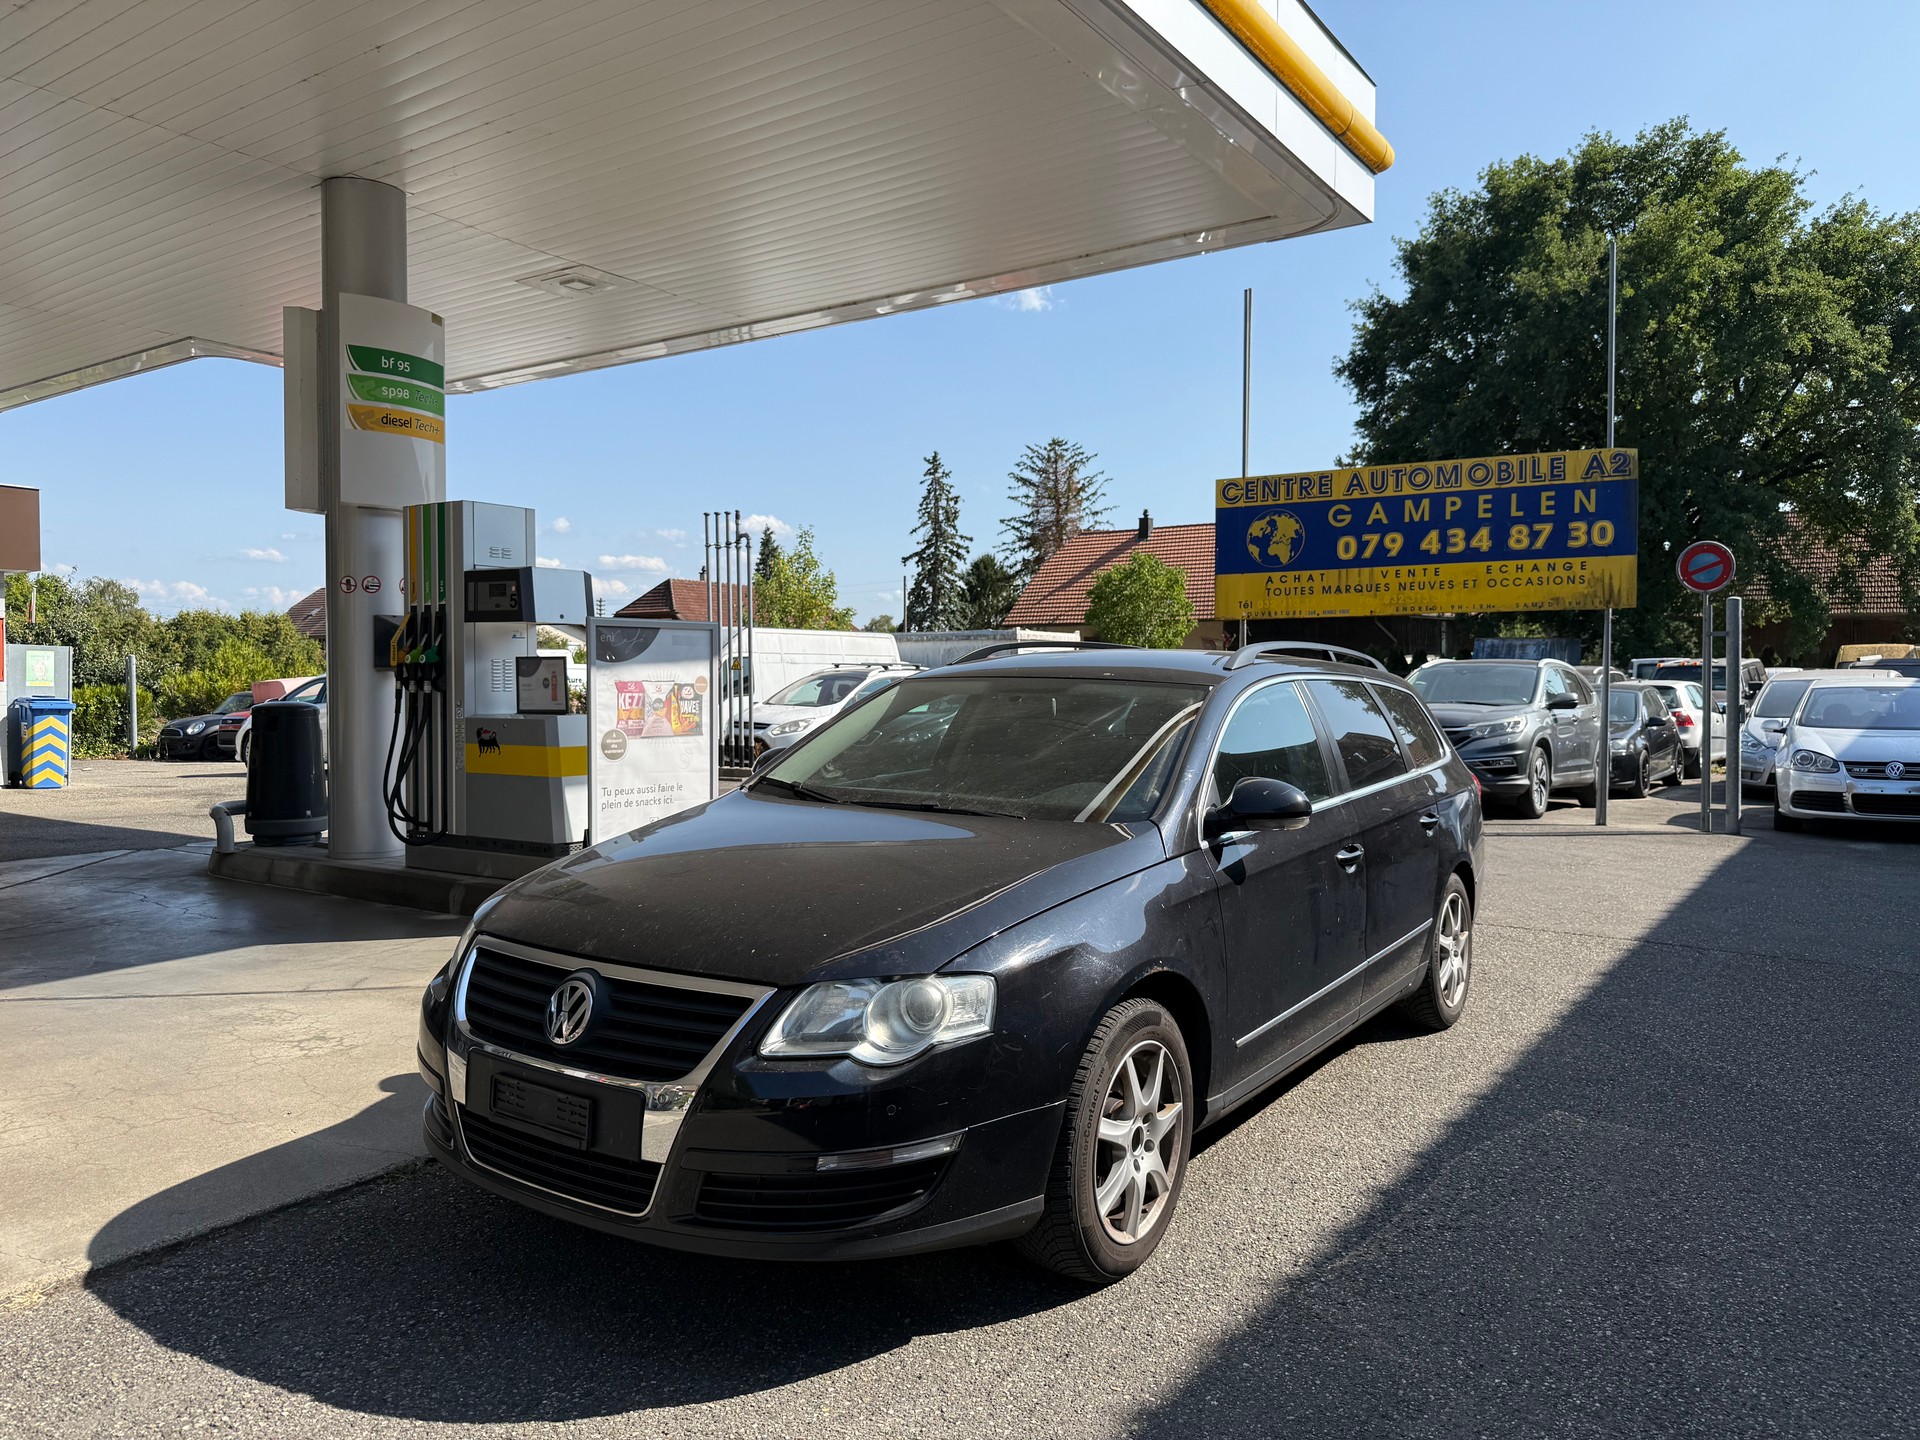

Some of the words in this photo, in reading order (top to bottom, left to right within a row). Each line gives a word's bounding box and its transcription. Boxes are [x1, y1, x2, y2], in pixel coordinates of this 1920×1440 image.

[381, 355, 395, 369] bf
[397, 360, 411, 373] 95
[381, 386, 410, 399] sp98
[380, 413, 412, 429] diesel
[414, 418, 440, 434] Tech+
[1220, 473, 1333, 504] CENTRE
[1343, 454, 1566, 497] AUTOMOBILE
[1580, 452, 1632, 478] A2
[1327, 488, 1597, 527] GAMPELEN
[1336, 532, 1404, 561] 079
[1420, 526, 1493, 556] 434
[1507, 522, 1554, 551] 87
[1566, 519, 1615, 549] 30
[1265, 572, 1326, 585] ACHAT
[1380, 567, 1441, 580] VENTE
[1486, 560, 1588, 575] ECHANGE
[1265, 582, 1315, 597] TOUTES
[1321, 582, 1391, 595] MARQUES
[1398, 579, 1455, 592] NEUVES
[1463, 578, 1478, 589] ET
[1486, 574, 1587, 588] OCCASIONS
[509, 593, 518, 609] 5
[1238, 600, 1253, 609] Tél
[601, 787, 612, 797] Tu
[614, 787, 635, 798] peux
[636, 783, 656, 795] aussi
[657, 782, 675, 793] faire
[676, 782, 683, 791] le
[601, 799, 622, 812] plein
[623, 798, 634, 808] de
[635, 796, 662, 807] snacks
